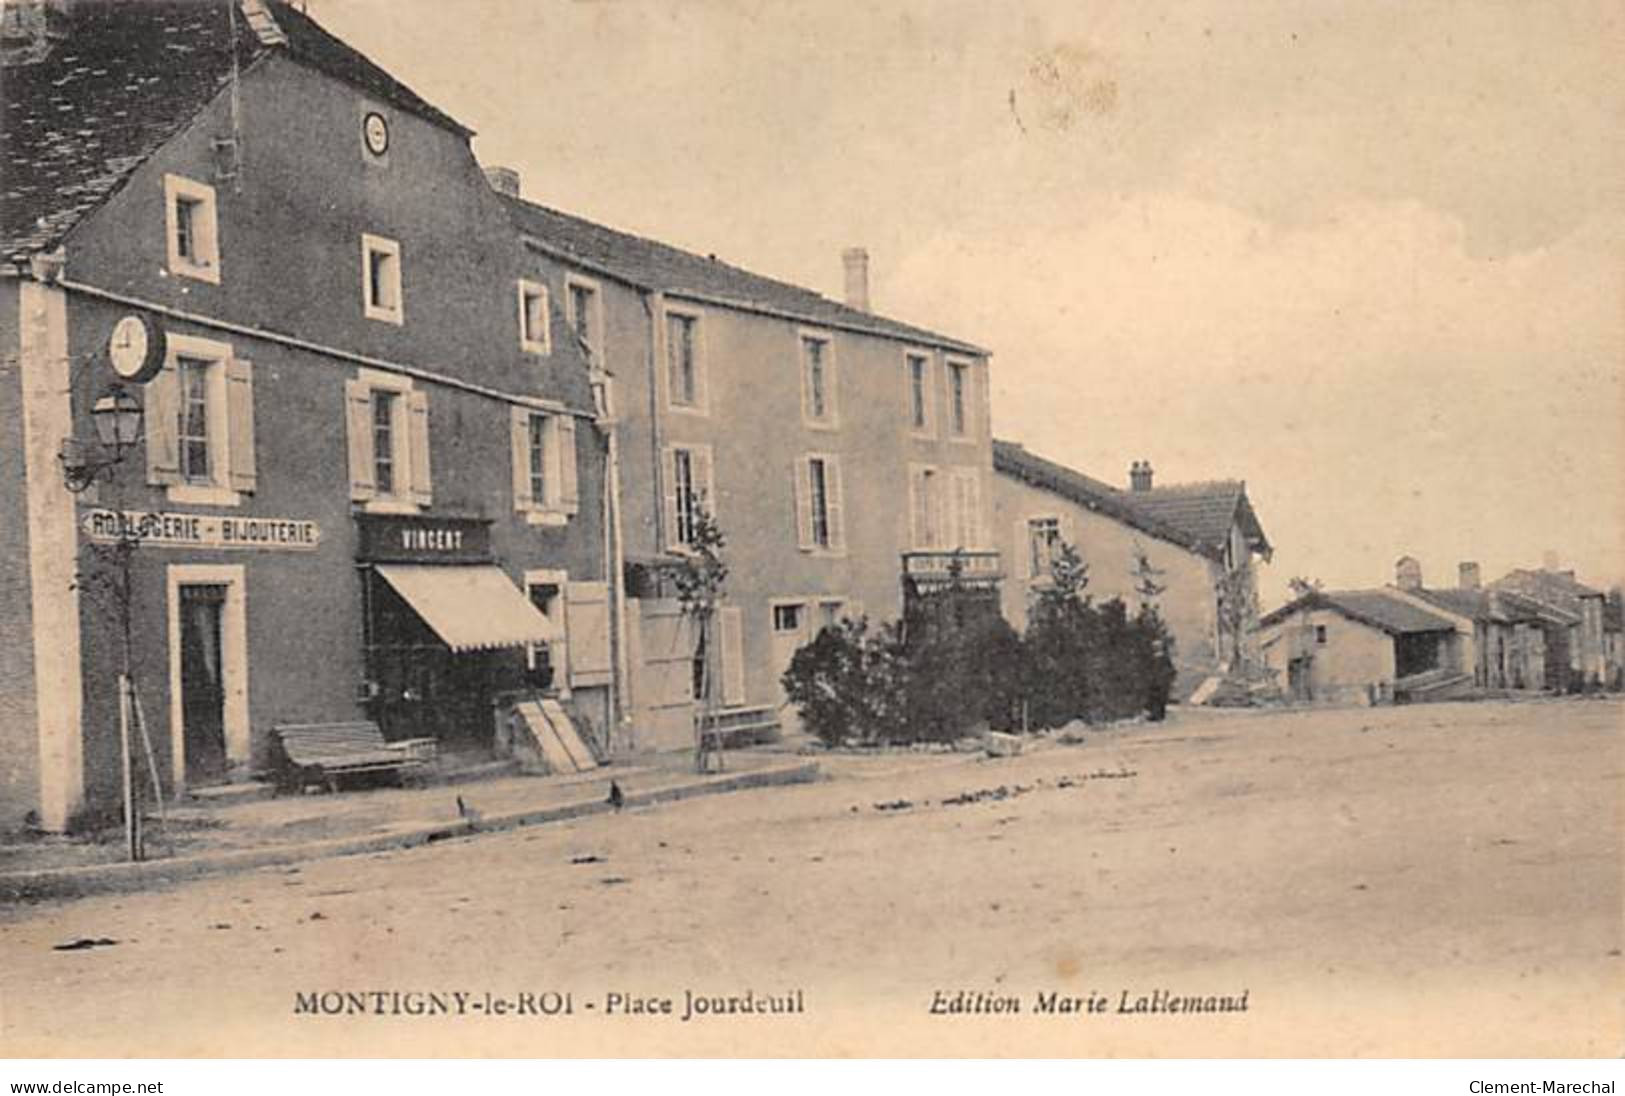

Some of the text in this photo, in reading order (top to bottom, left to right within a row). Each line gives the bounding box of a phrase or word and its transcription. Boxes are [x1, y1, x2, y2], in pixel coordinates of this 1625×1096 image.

[92, 512, 200, 539] HOLOGERIE
[222, 520, 313, 543] BIJOUTERIE
[401, 529, 461, 550] VINCENT
